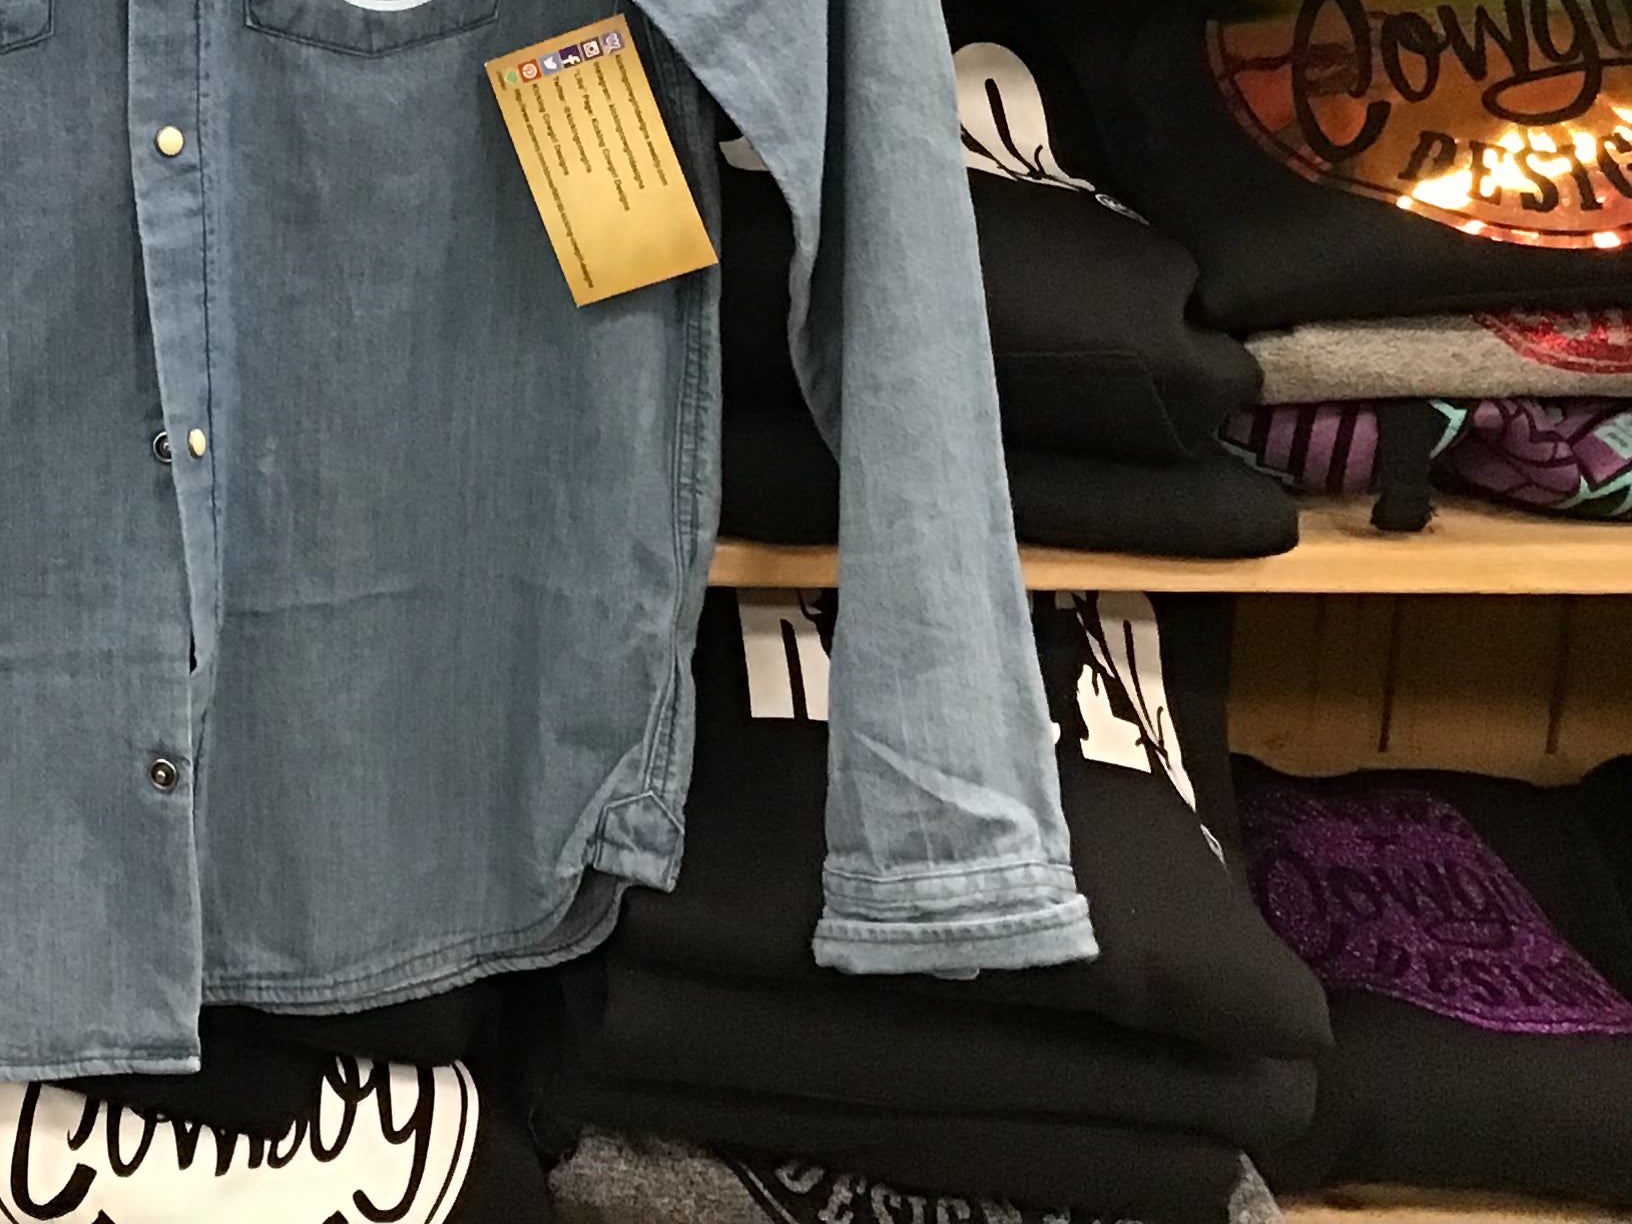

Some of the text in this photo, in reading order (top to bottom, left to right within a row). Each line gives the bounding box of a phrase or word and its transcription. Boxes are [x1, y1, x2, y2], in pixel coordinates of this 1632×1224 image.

[531, 83, 569, 175] Kicking Cowgirl Designs
[591, 118, 605, 147] Kicking
[602, 148, 617, 178] Cowgirl
[614, 179, 629, 211] Designs
